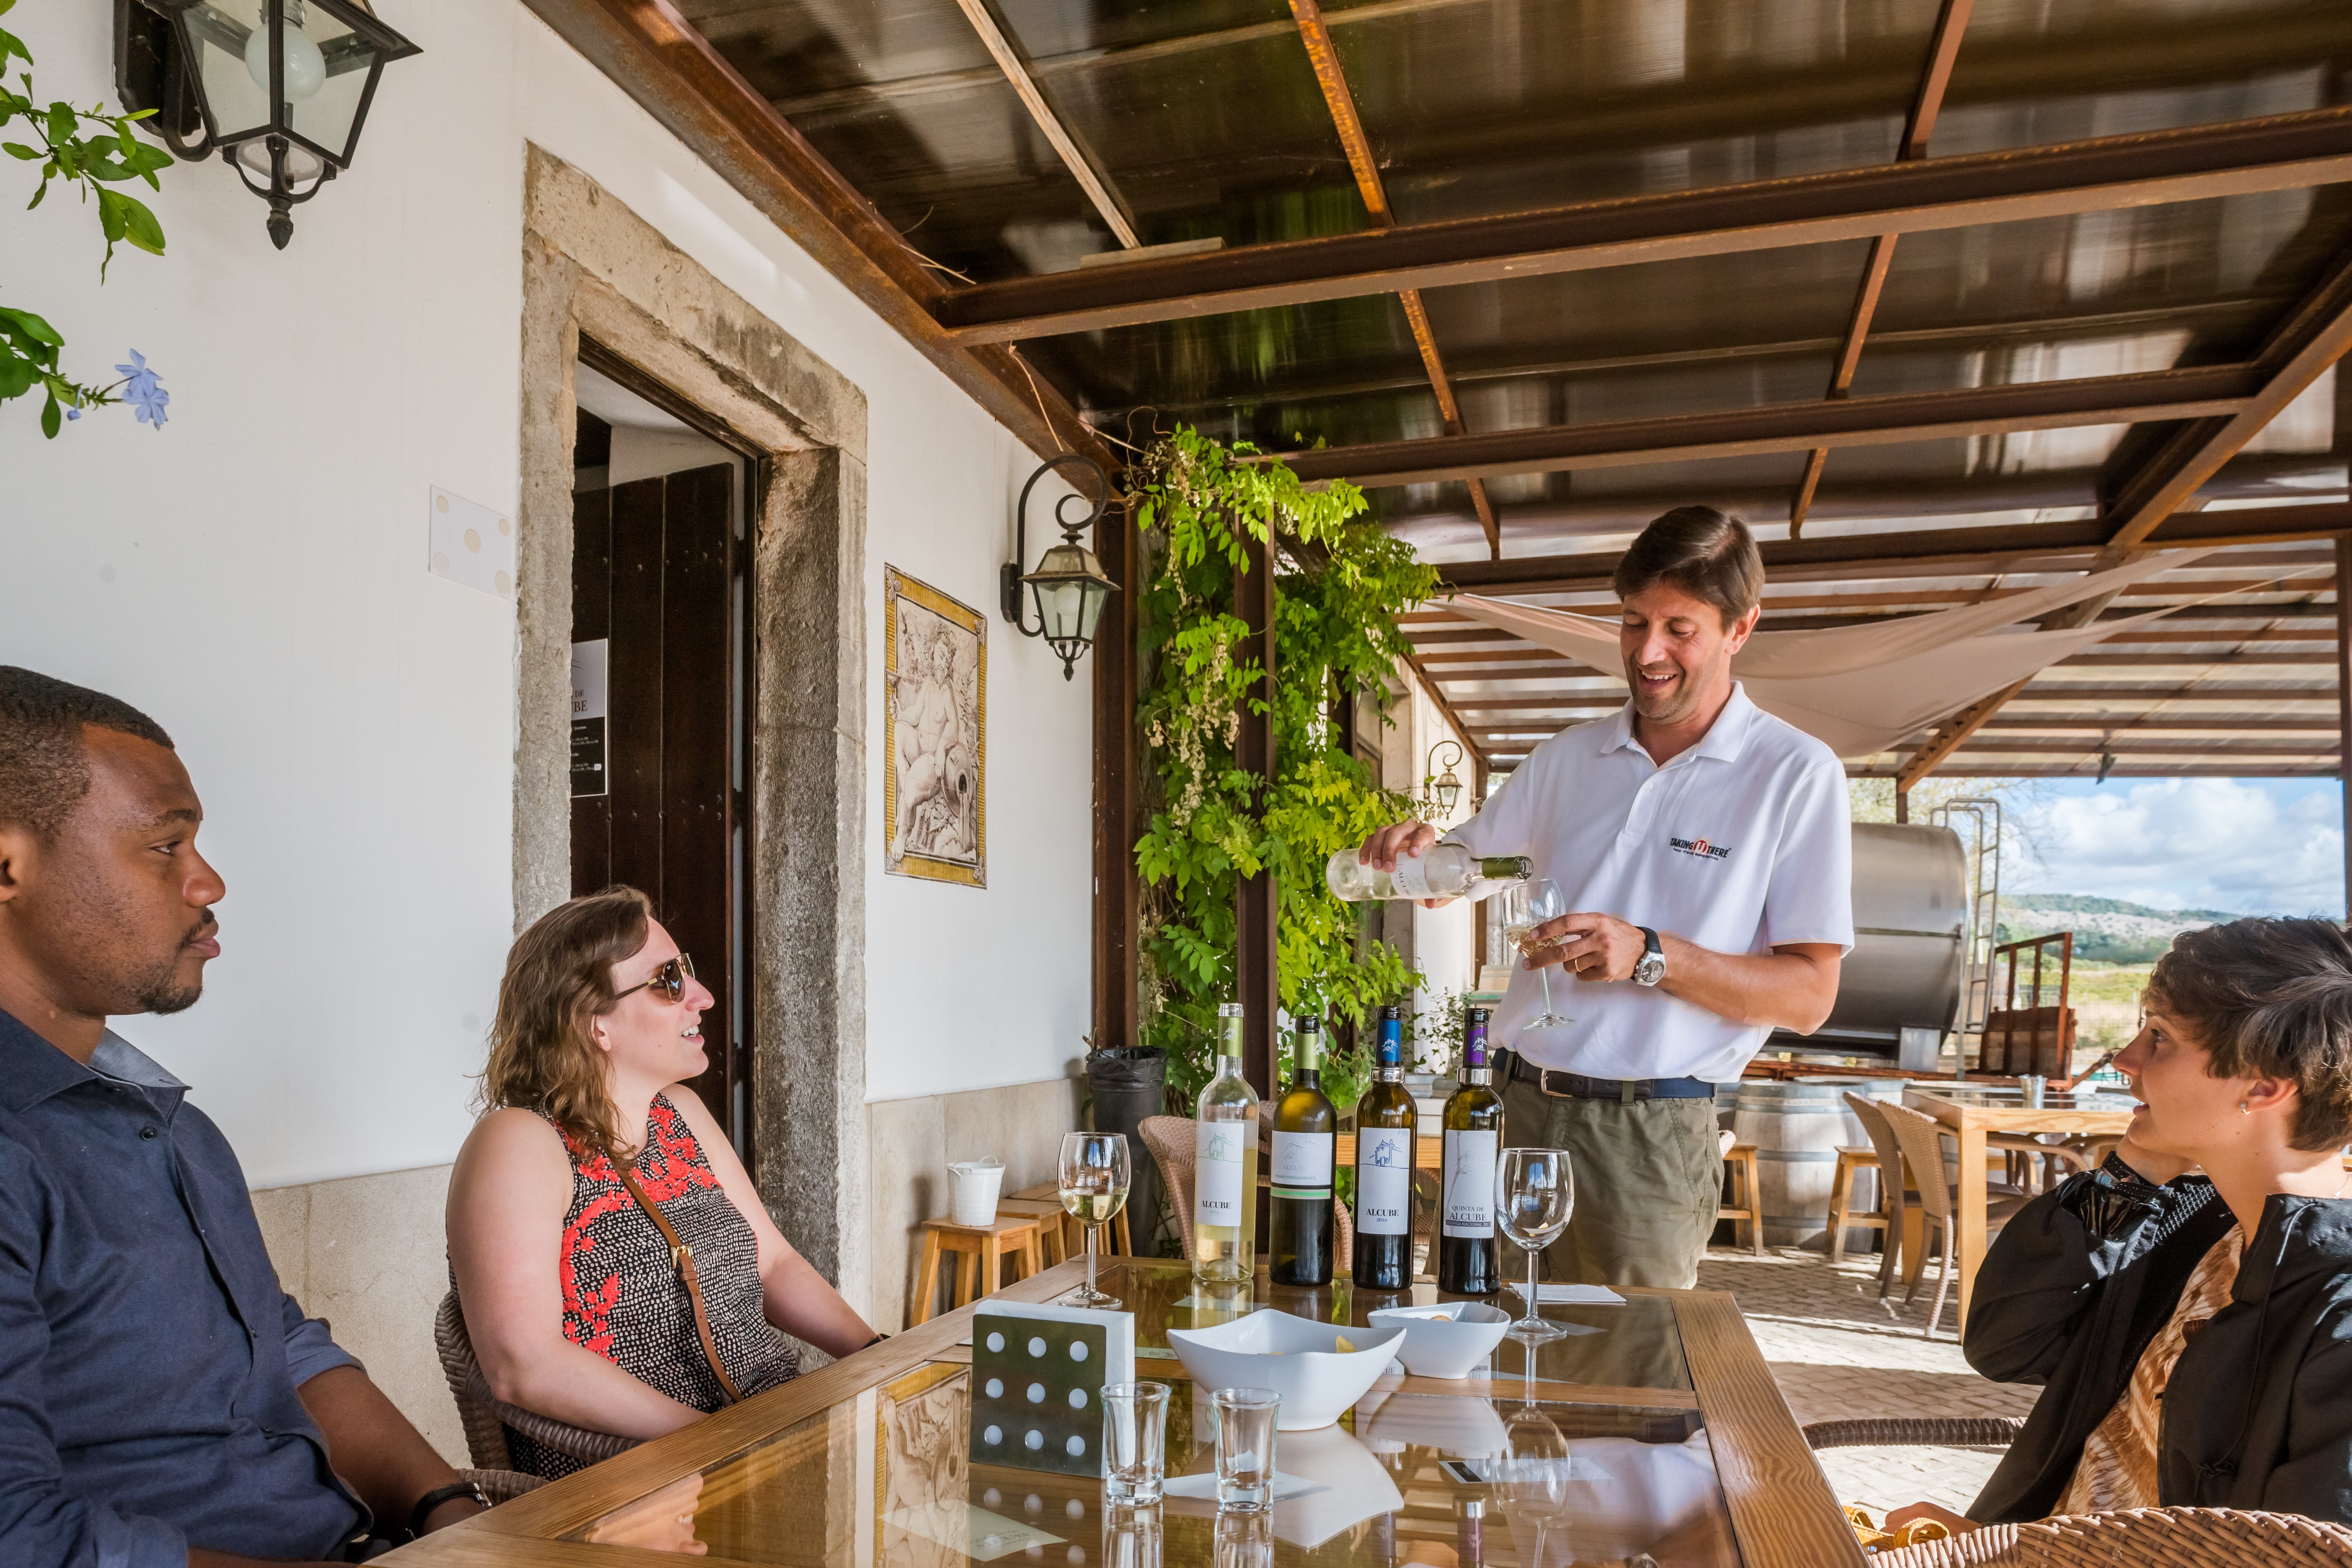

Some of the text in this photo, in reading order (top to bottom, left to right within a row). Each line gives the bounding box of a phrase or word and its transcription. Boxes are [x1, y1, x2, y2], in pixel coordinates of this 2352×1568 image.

[575, 690, 584, 698] DE
[1670, 838, 1694, 850] TAKING
[1201, 1200, 1231, 1209] ALCUBE
[1366, 1208, 1399, 1217] ALCUBE
[1450, 1212, 1487, 1221] ALCUBE
